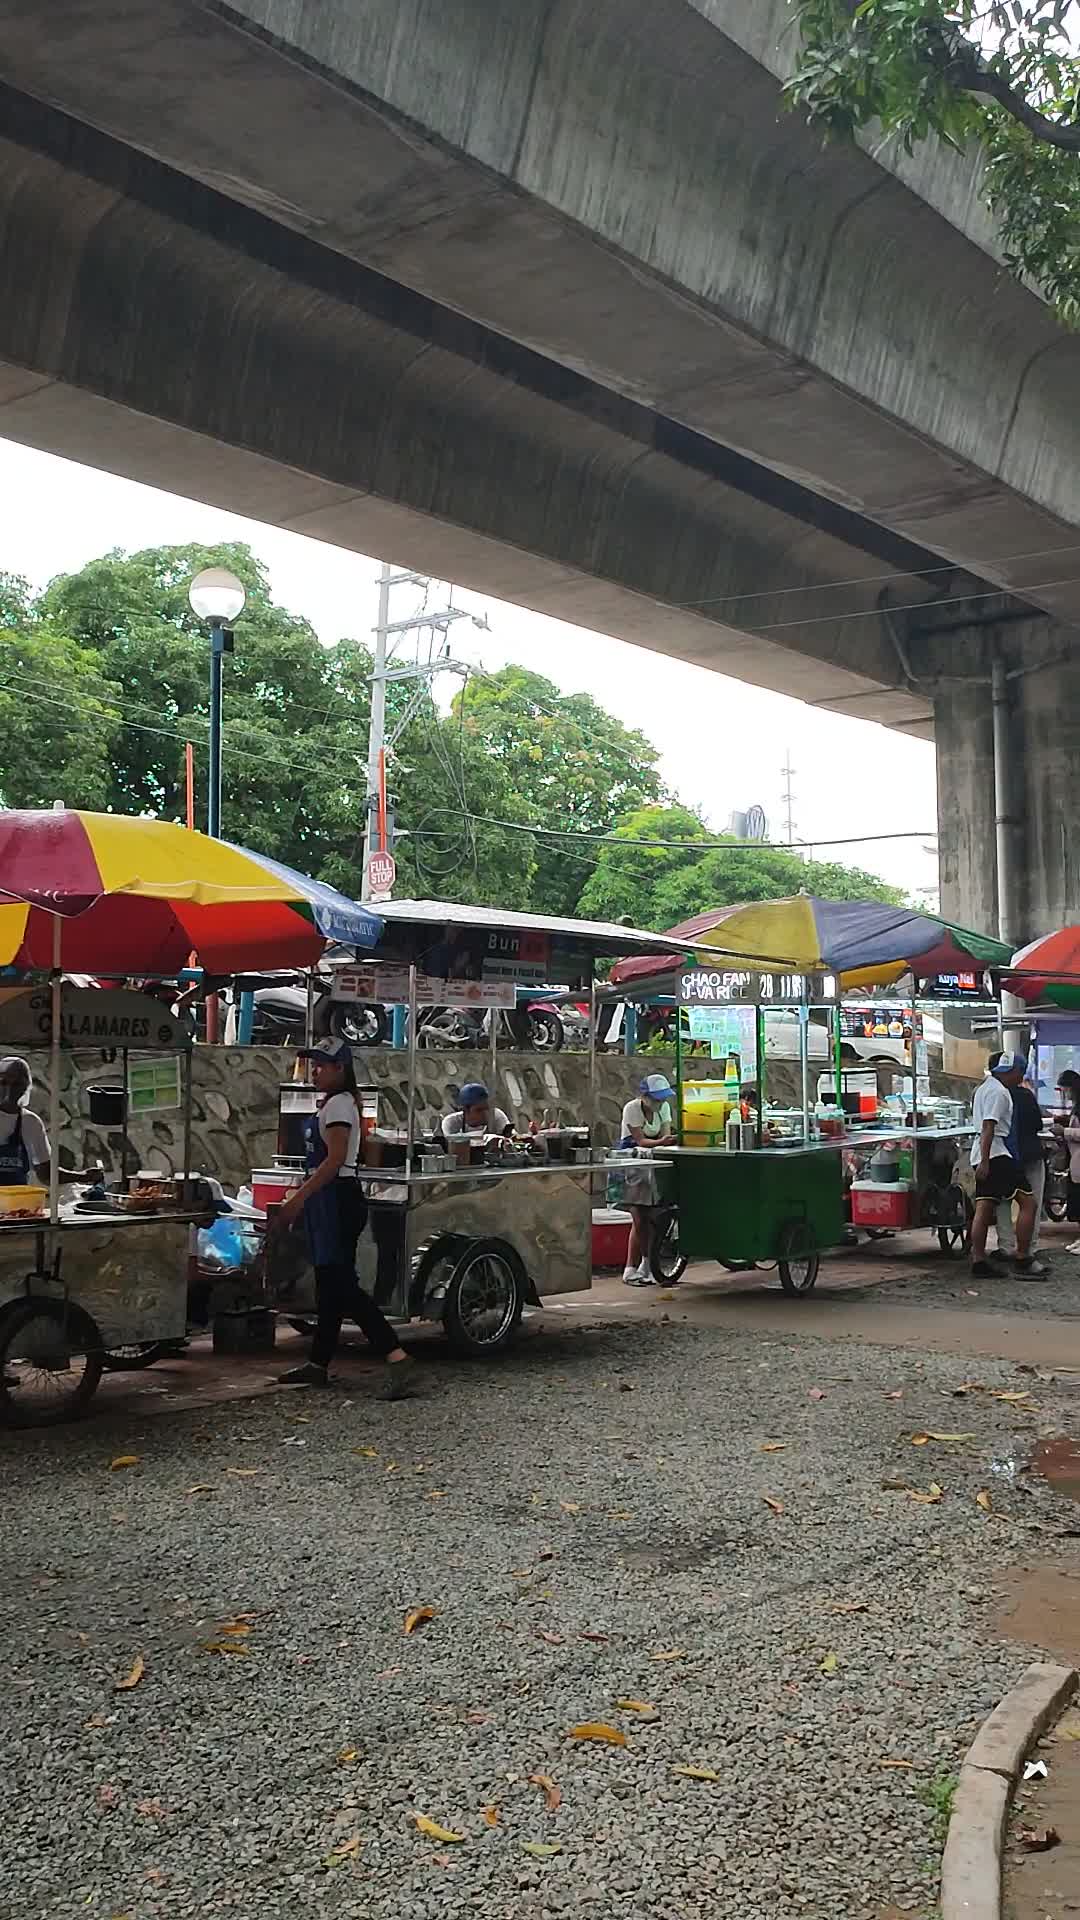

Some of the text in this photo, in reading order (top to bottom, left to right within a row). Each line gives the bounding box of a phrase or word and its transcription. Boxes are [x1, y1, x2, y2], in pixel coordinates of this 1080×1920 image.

[370, 859, 392, 873] FULL
[371, 870, 393, 884] STOP
[681, 972, 721, 987] CHAO
[37, 1013, 151, 1038] CLAMARES
